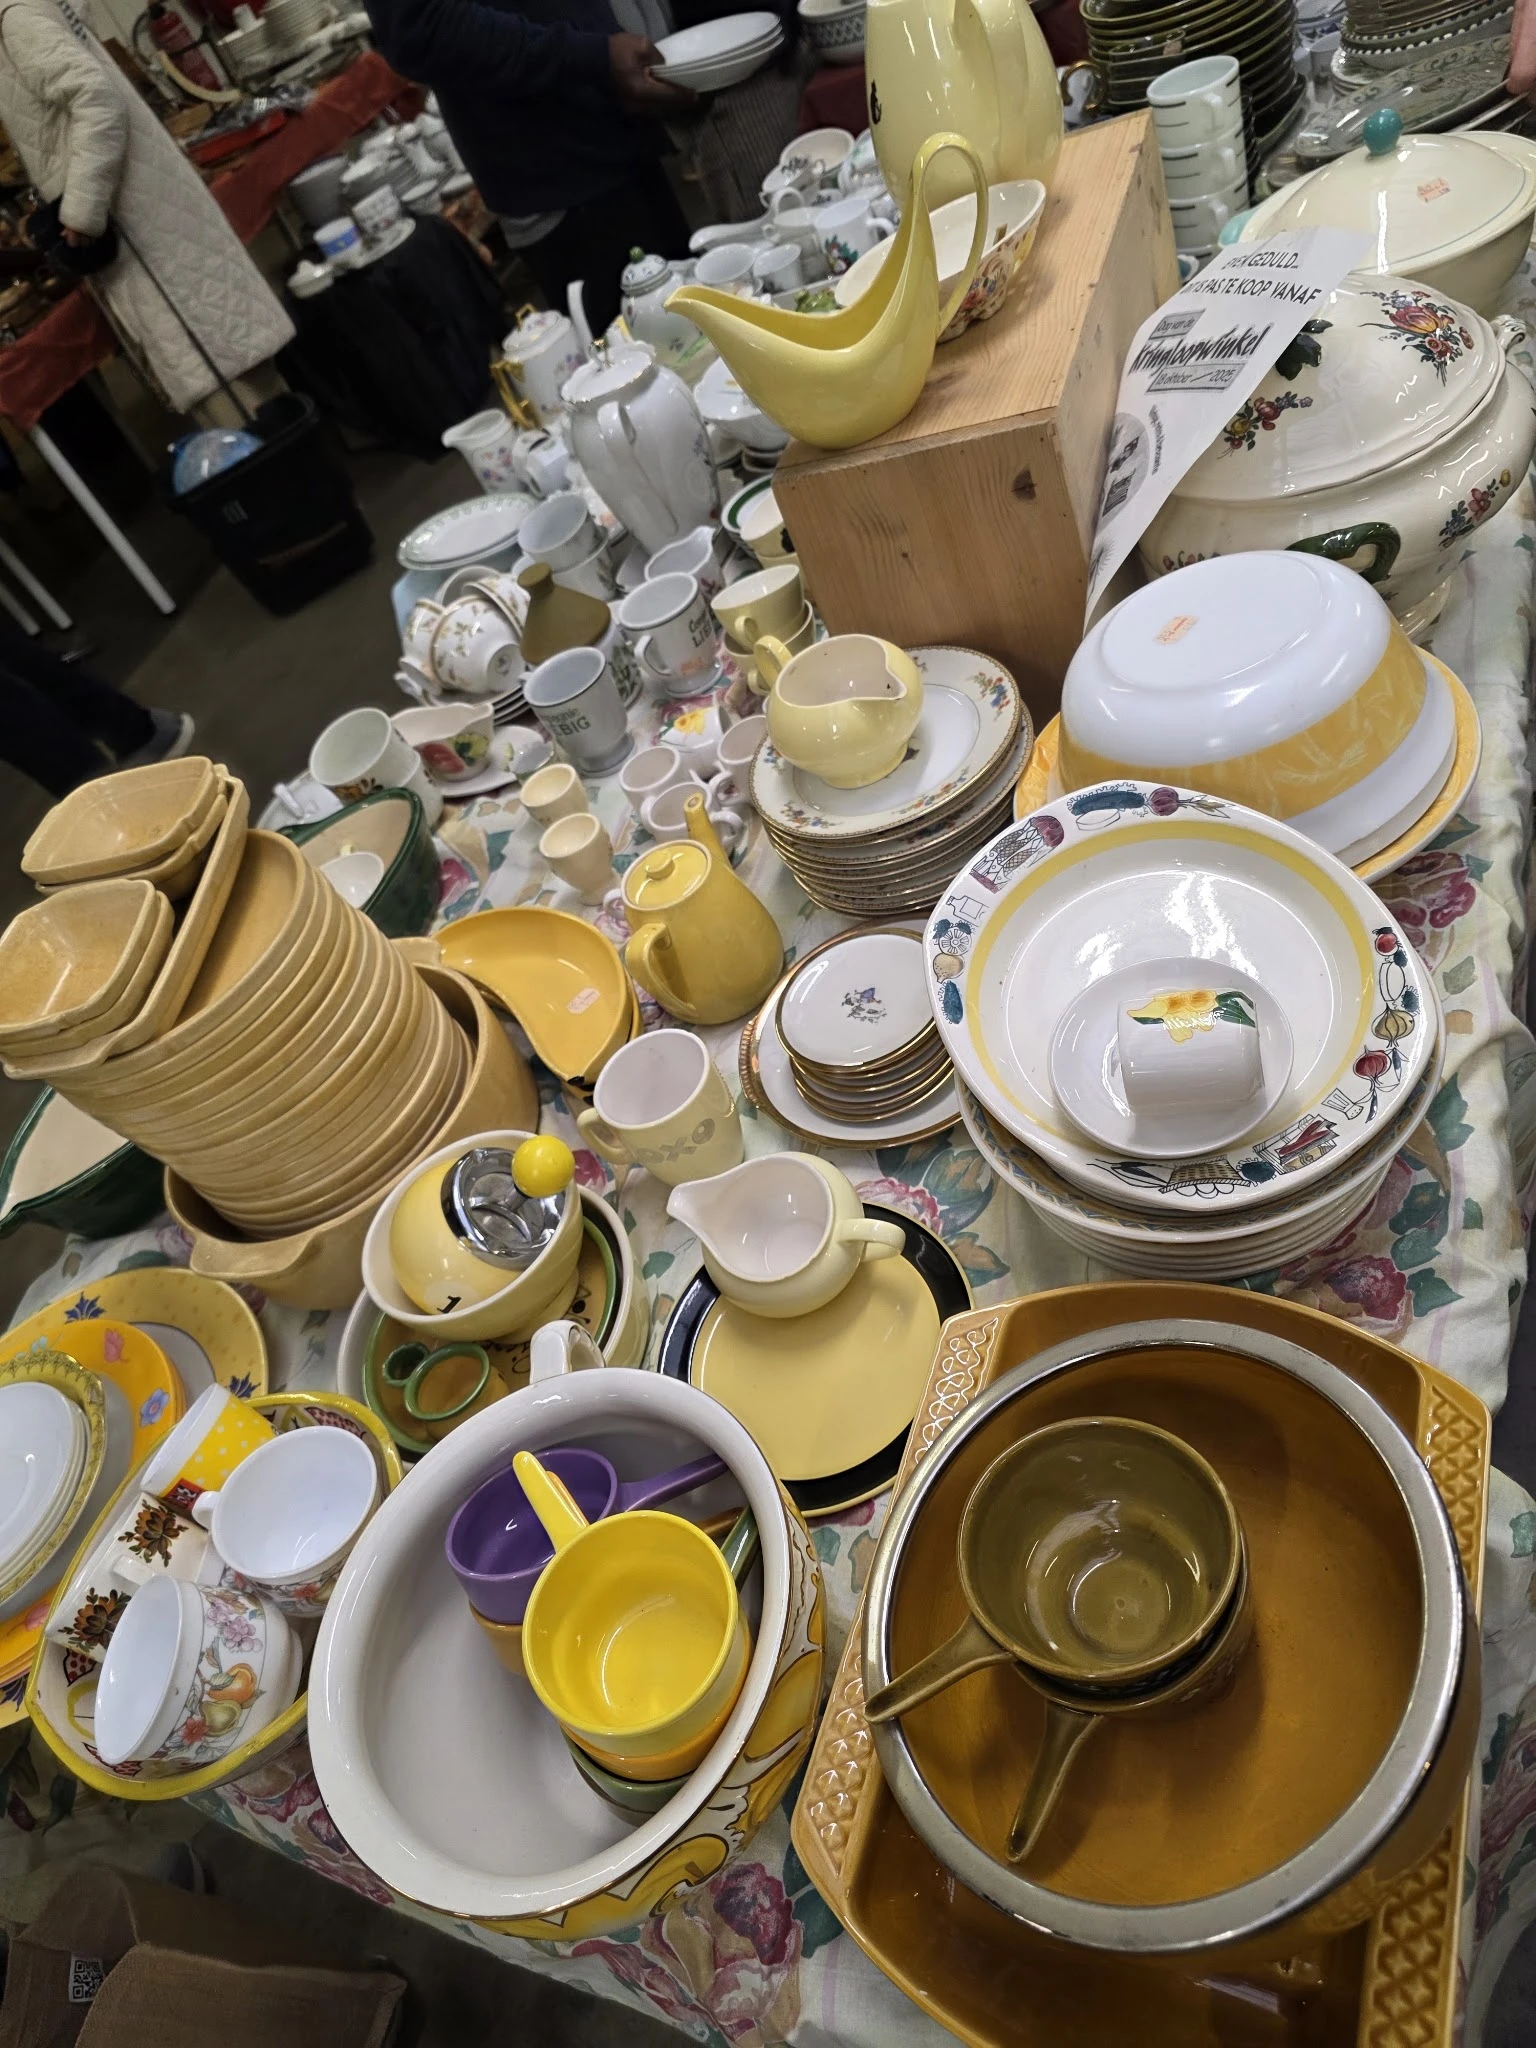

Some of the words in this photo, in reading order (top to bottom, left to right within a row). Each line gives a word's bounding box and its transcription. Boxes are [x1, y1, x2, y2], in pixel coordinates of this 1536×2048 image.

[1201, 278, 1227, 295] PAS
[1221, 278, 1240, 294] TE
[1233, 278, 1273, 297] KOOP
[1269, 281, 1323, 306] VANAF
[1129, 325, 1271, 377] Kringloopwinkel
[1209, 369, 1236, 382] 2025
[436, 1294, 462, 1314] 1
